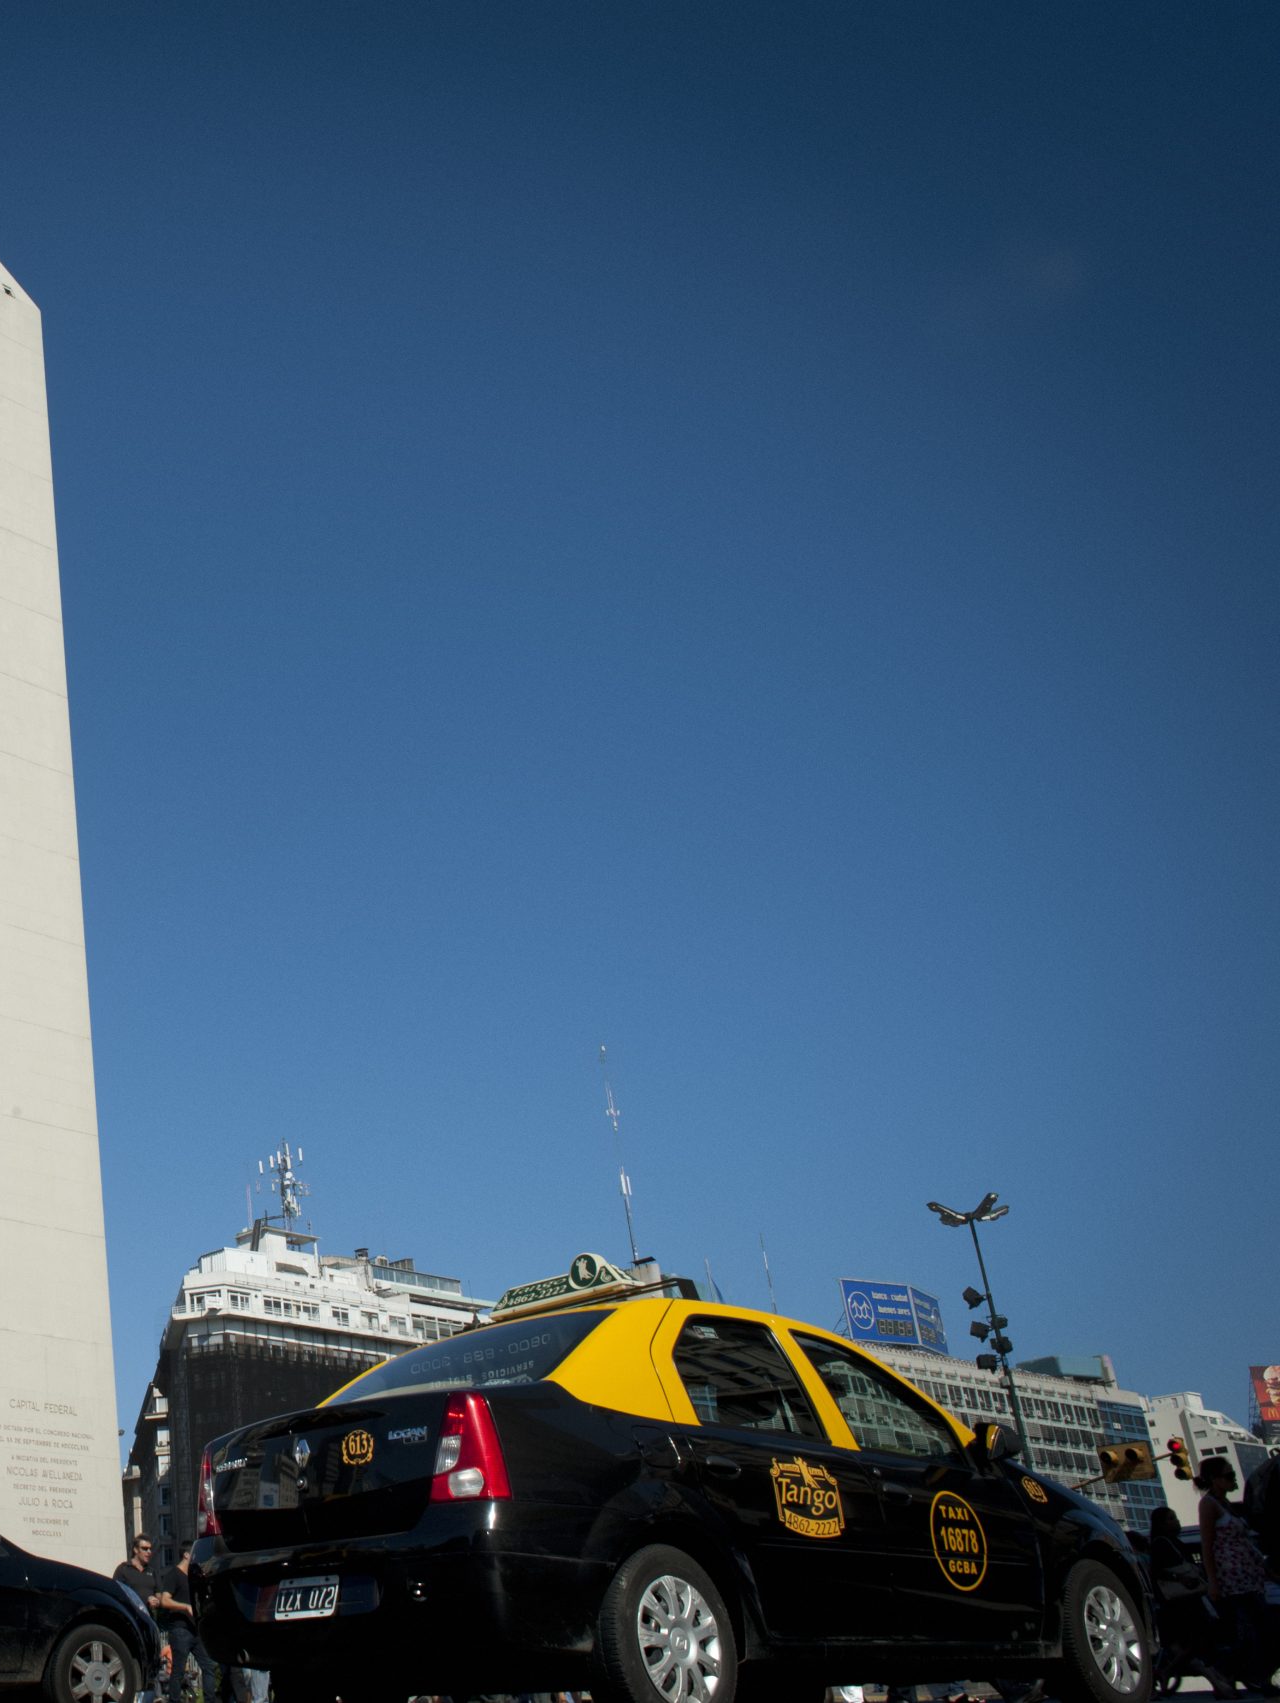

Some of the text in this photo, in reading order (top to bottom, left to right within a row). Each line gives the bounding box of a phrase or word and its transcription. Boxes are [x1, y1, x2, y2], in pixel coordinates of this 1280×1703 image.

[507, 1285, 567, 1306] 4862-2222
[481, 1360, 535, 1380] SERVICIOS
[9, 1398, 78, 1417] CAPITAL FEDERAL
[388, 1425, 428, 1441] LOGAN
[348, 1434, 368, 1455] 613
[6, 1466, 83, 1481] NICOLAS AVELLANEDA
[18, 1496, 40, 1507] JULIO
[52, 1498, 73, 1509] ROCA
[778, 1478, 837, 1516] Tango
[938, 1505, 969, 1520] TAXI
[787, 1512, 839, 1535] 4862-2222
[940, 1526, 979, 1554] 16878
[948, 1559, 978, 1575] GCBA
[277, 1585, 335, 1612] IZX 072
